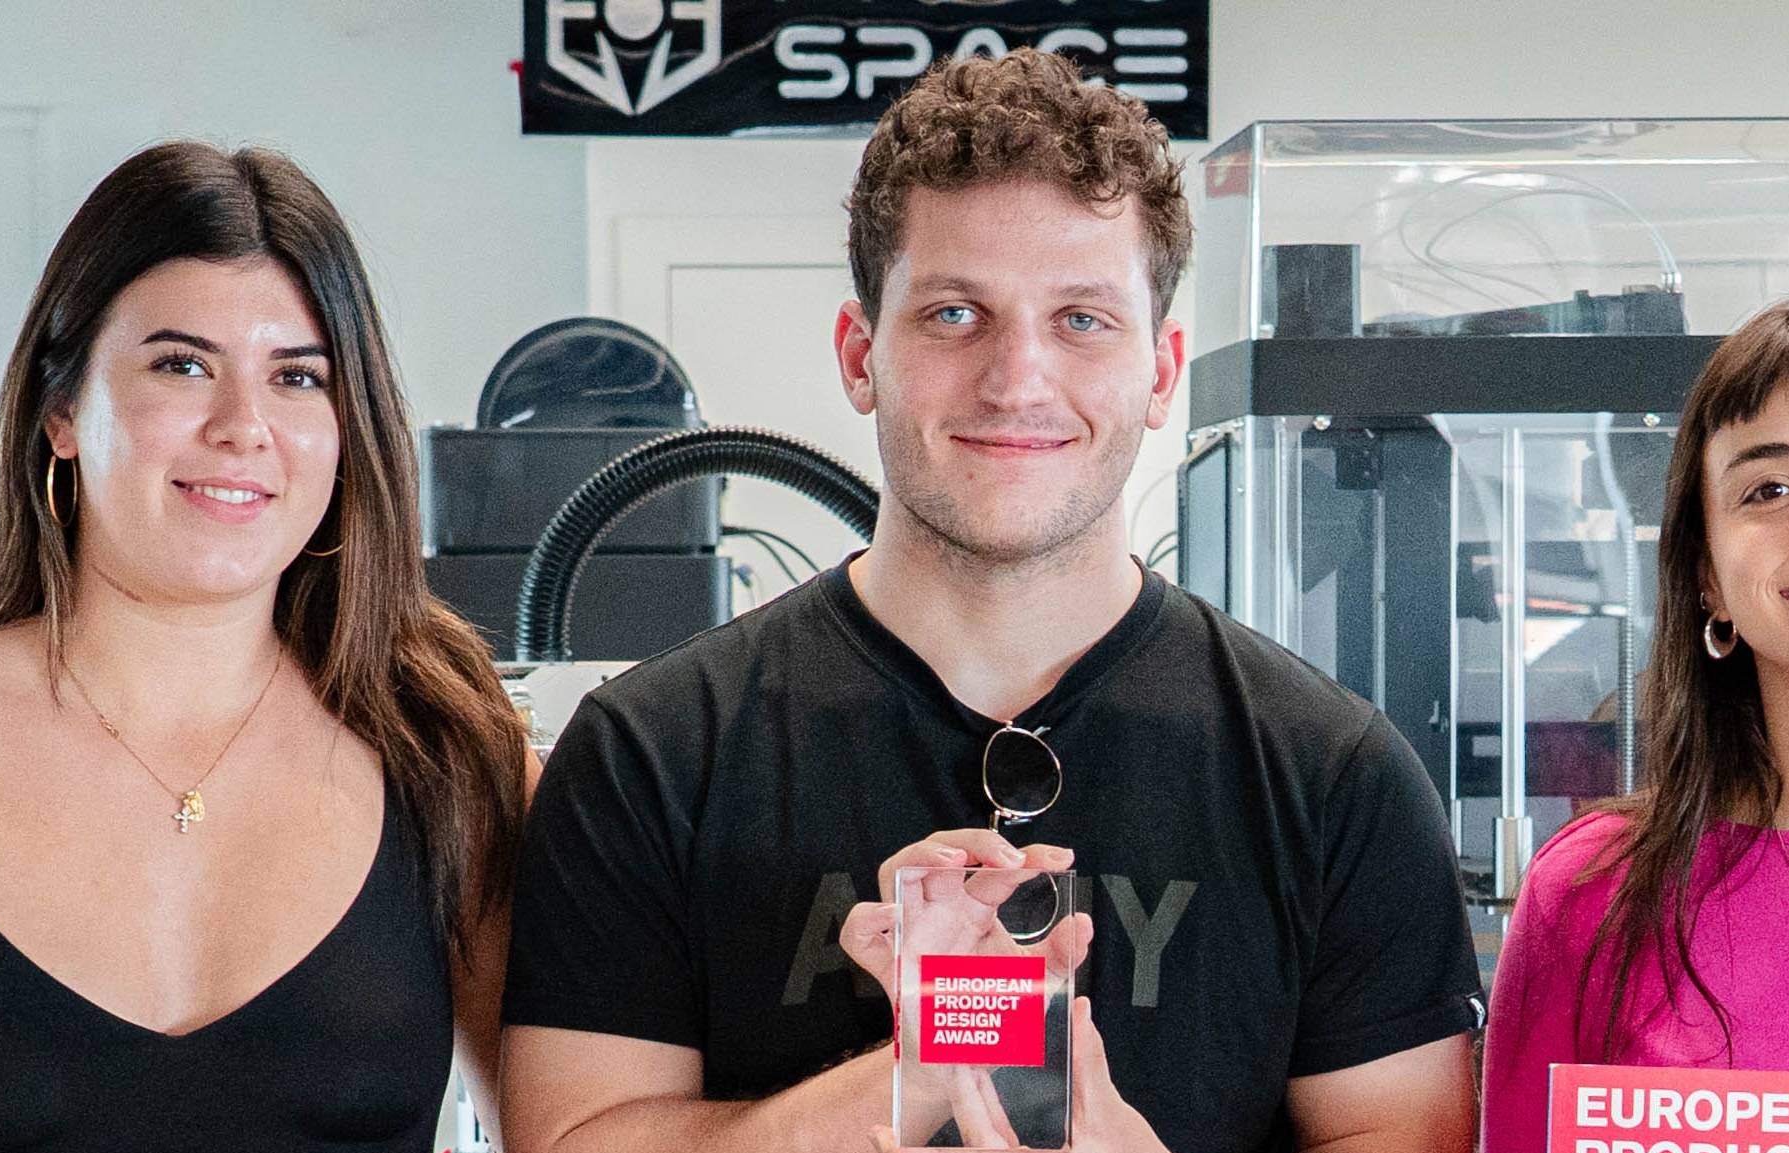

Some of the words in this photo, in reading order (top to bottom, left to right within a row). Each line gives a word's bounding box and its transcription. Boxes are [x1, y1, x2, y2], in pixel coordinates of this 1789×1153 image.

[780, 872, 1199, 1008] AY
[934, 977, 1033, 993] EUROPEAN
[934, 995, 1020, 1011] PRODUCT
[934, 1012, 1002, 1028] DESIGN
[933, 1029, 1001, 1046] AWARD
